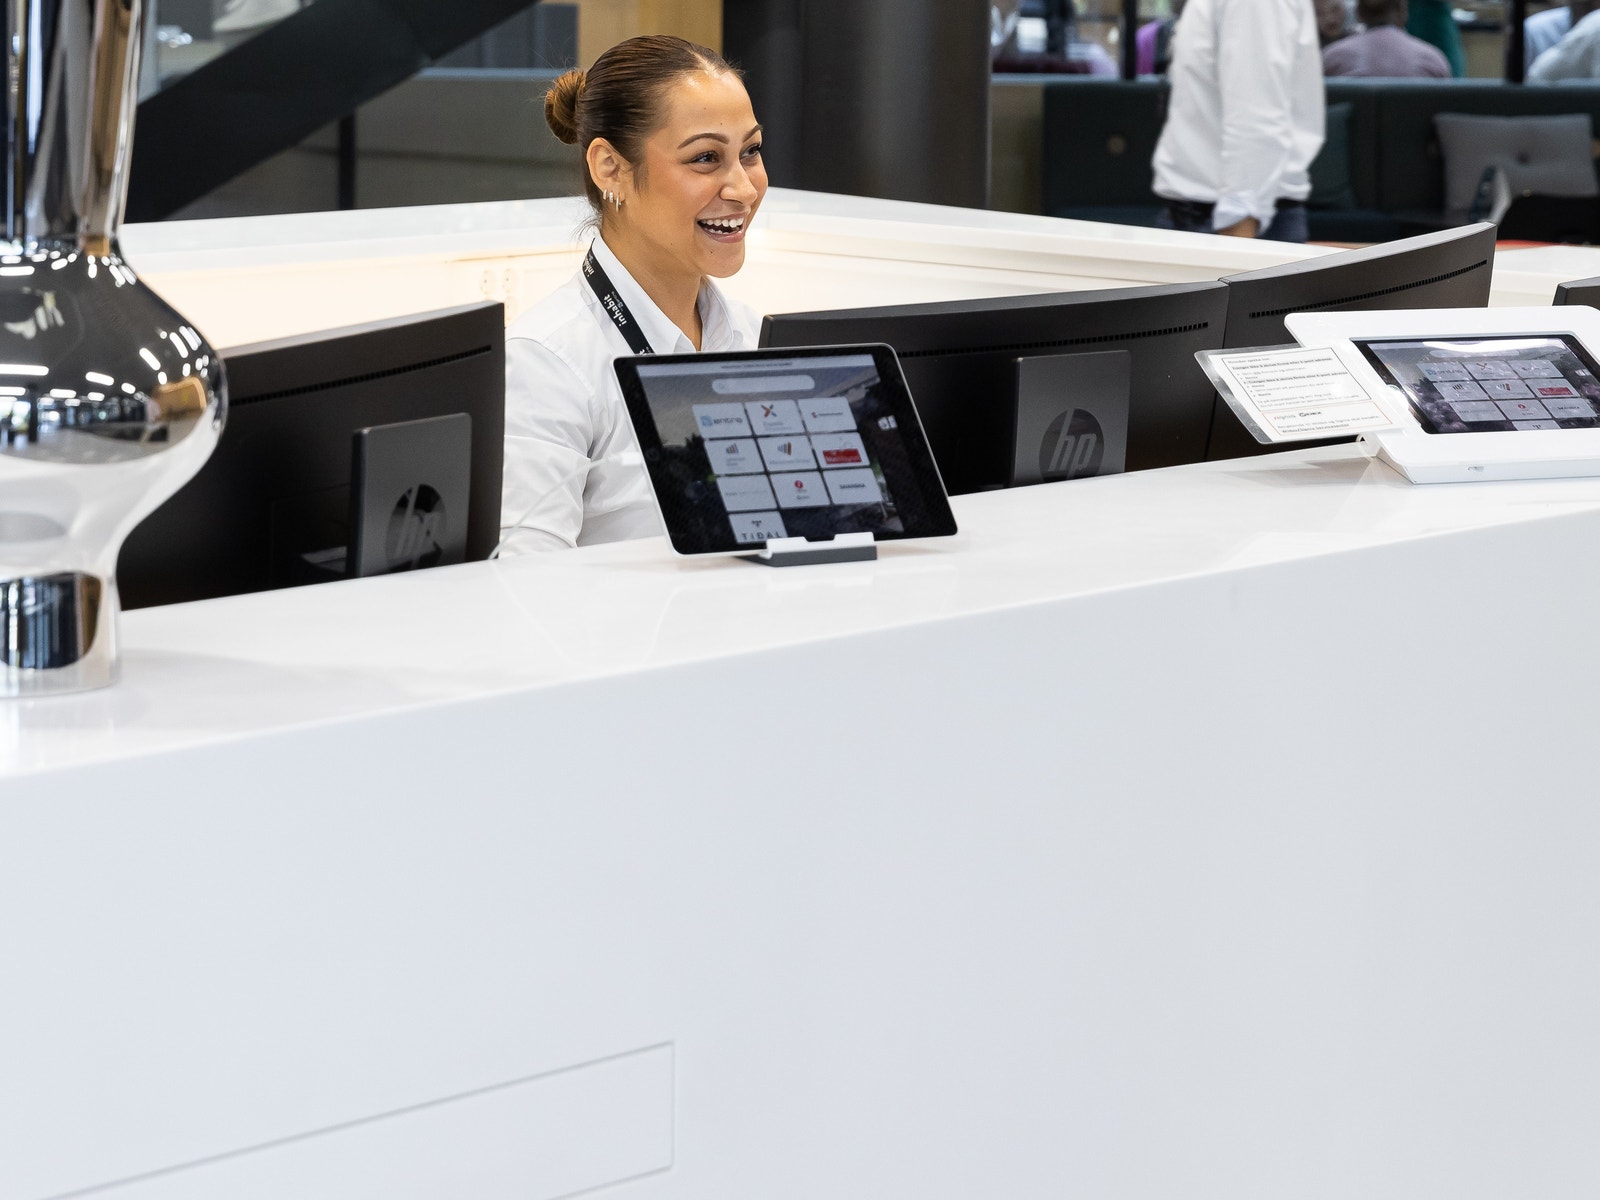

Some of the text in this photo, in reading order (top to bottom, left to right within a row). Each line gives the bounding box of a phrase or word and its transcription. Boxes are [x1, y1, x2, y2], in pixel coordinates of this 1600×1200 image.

[603, 293, 627, 327] inhabit
[1047, 407, 1098, 480] hp
[741, 531, 781, 541] TIDAL
